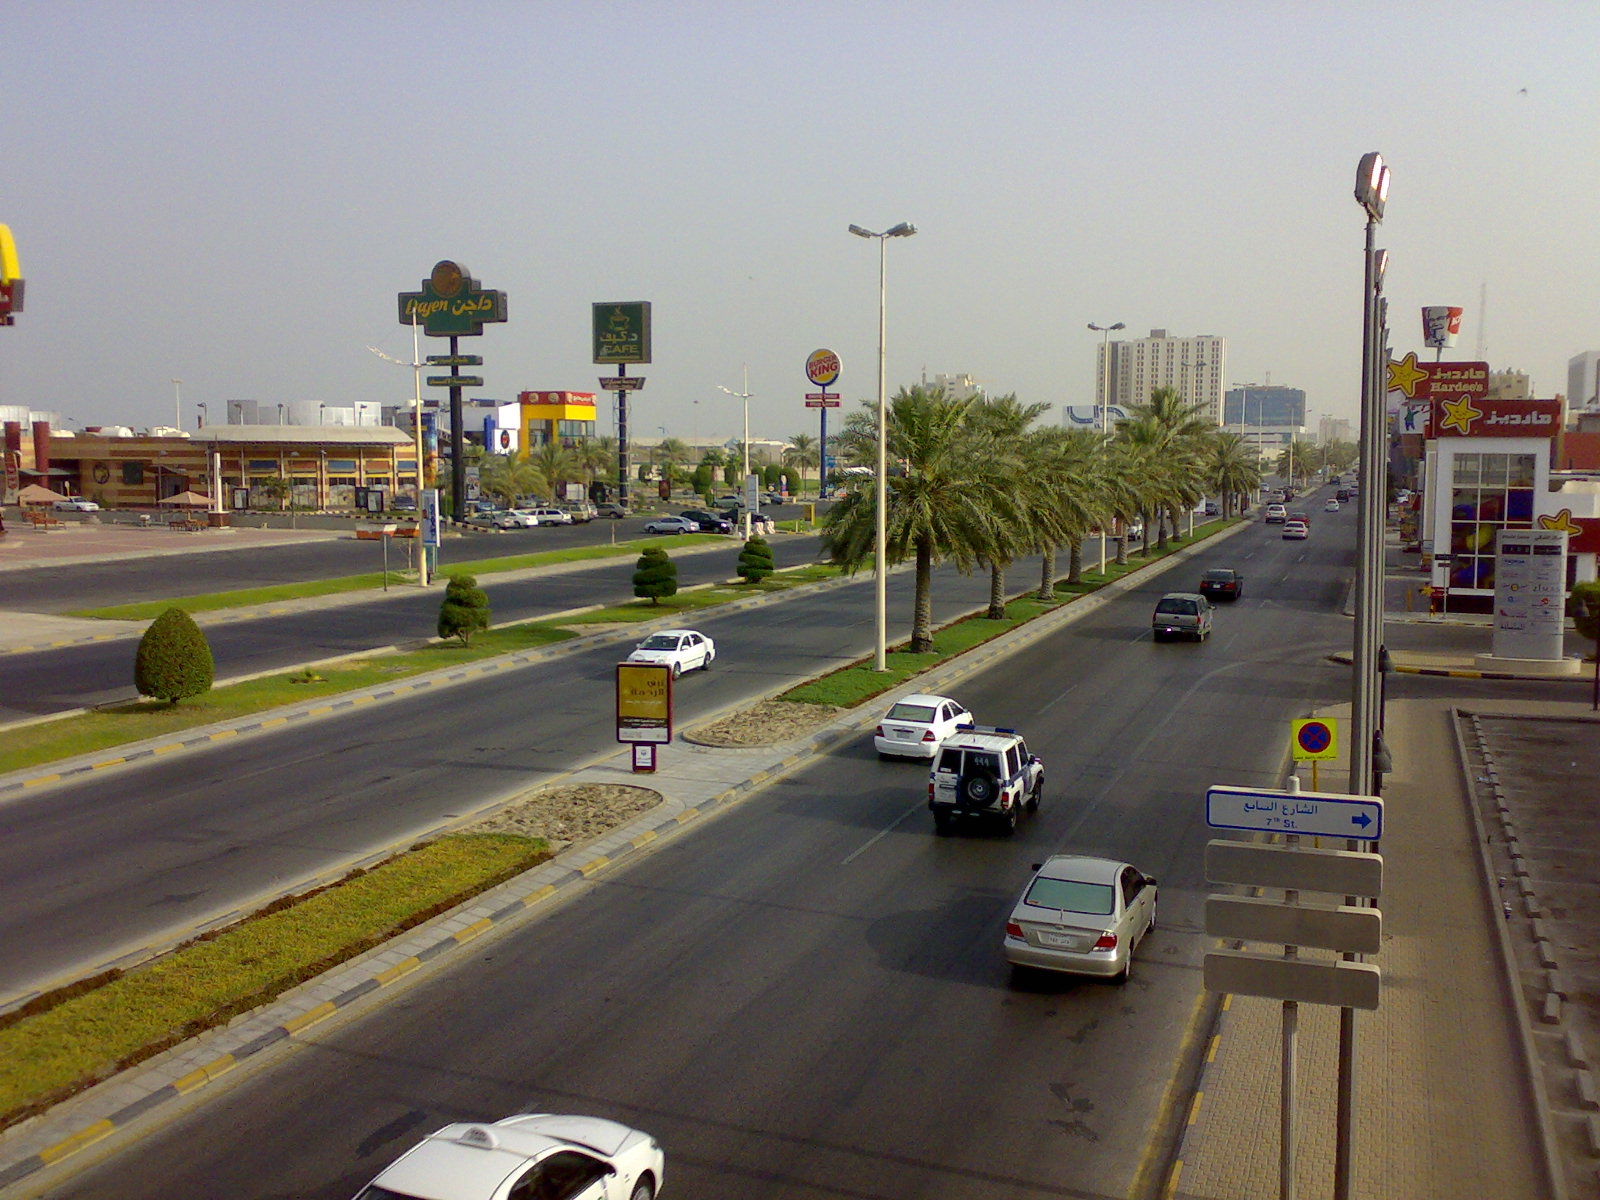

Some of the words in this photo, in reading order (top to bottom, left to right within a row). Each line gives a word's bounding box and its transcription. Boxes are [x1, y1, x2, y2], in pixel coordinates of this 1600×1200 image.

[451, 295, 493, 316] داجن
[808, 355, 837, 369] BURGER
[810, 362, 838, 378] KING
[1431, 367, 1486, 380] هارديز
[1430, 381, 1484, 392] Hardee's
[1484, 410, 1552, 425] هارديز
[1243, 799, 1277, 813] السابع
[1281, 802, 1318, 816] الشارع
